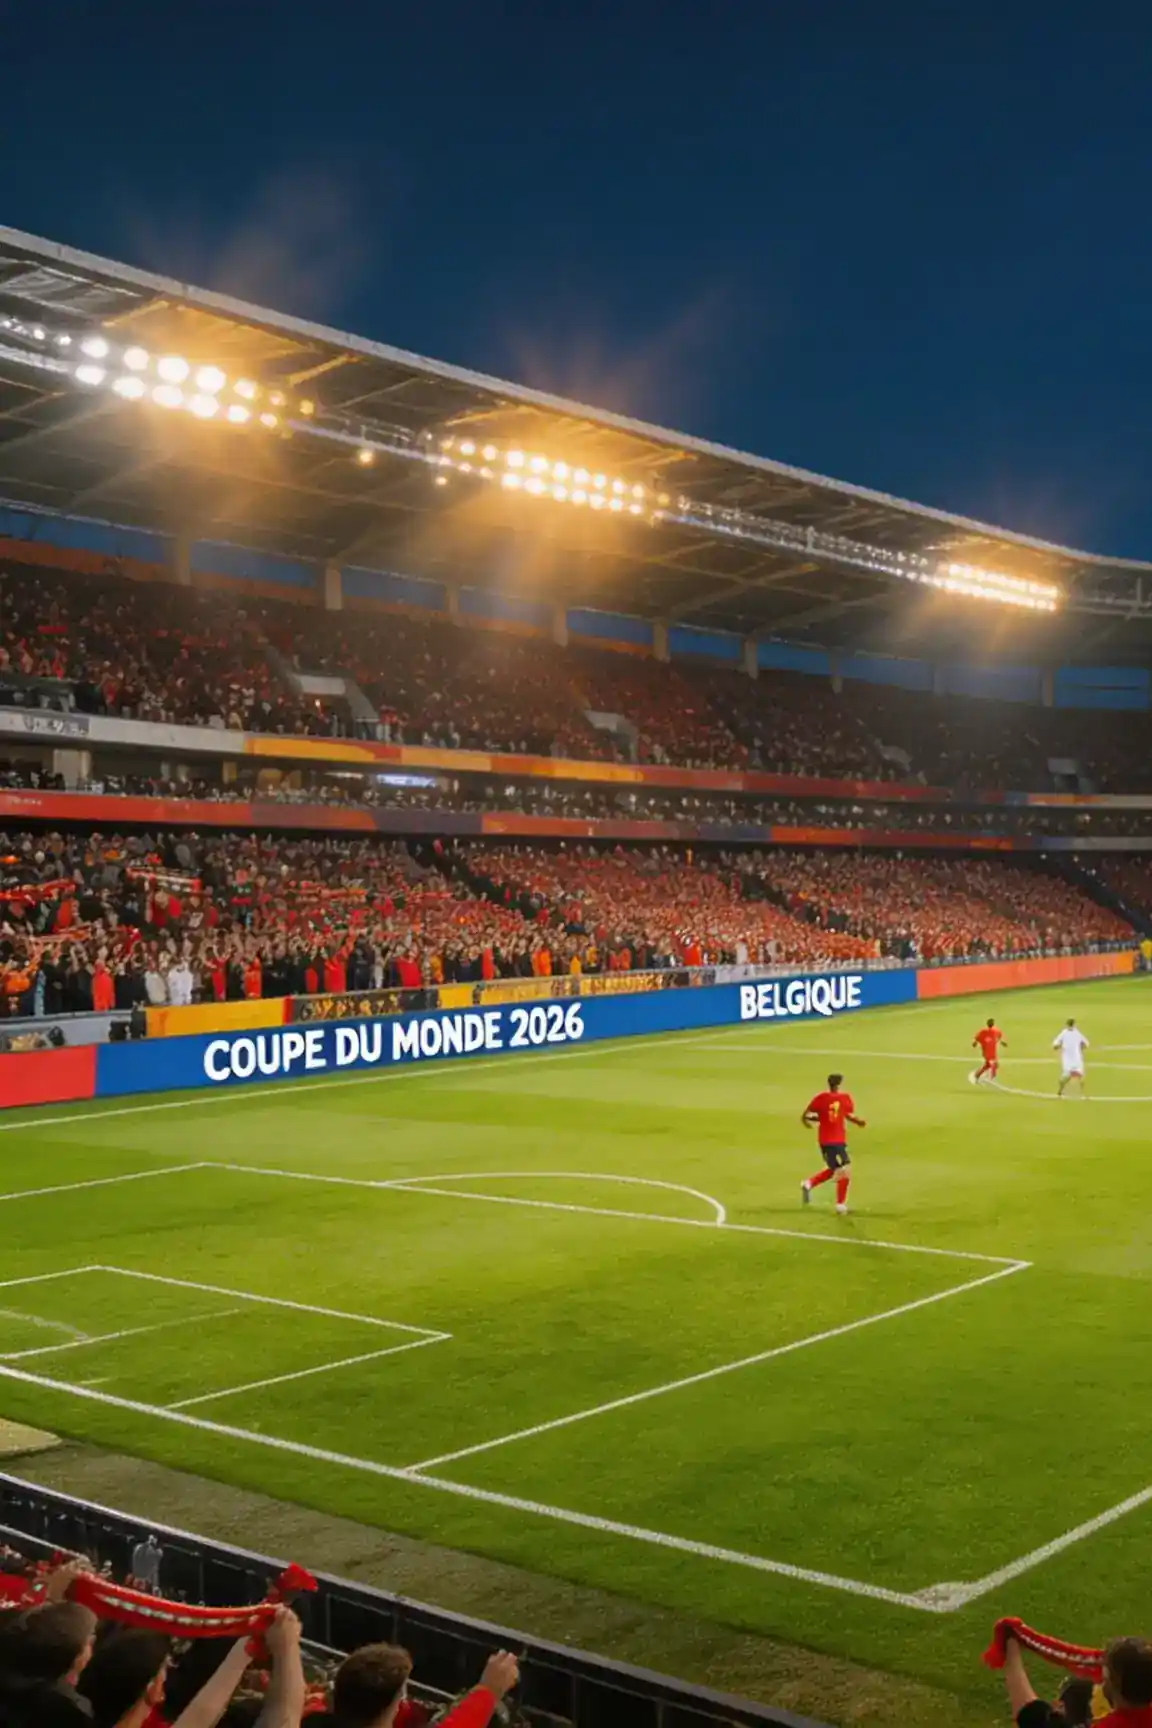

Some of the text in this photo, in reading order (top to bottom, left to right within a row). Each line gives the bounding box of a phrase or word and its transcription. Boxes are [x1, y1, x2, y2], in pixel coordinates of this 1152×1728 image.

[740, 976, 862, 1019] BELGIQUE
[203, 1002, 584, 1081] COUPE DU MONDE 2026
